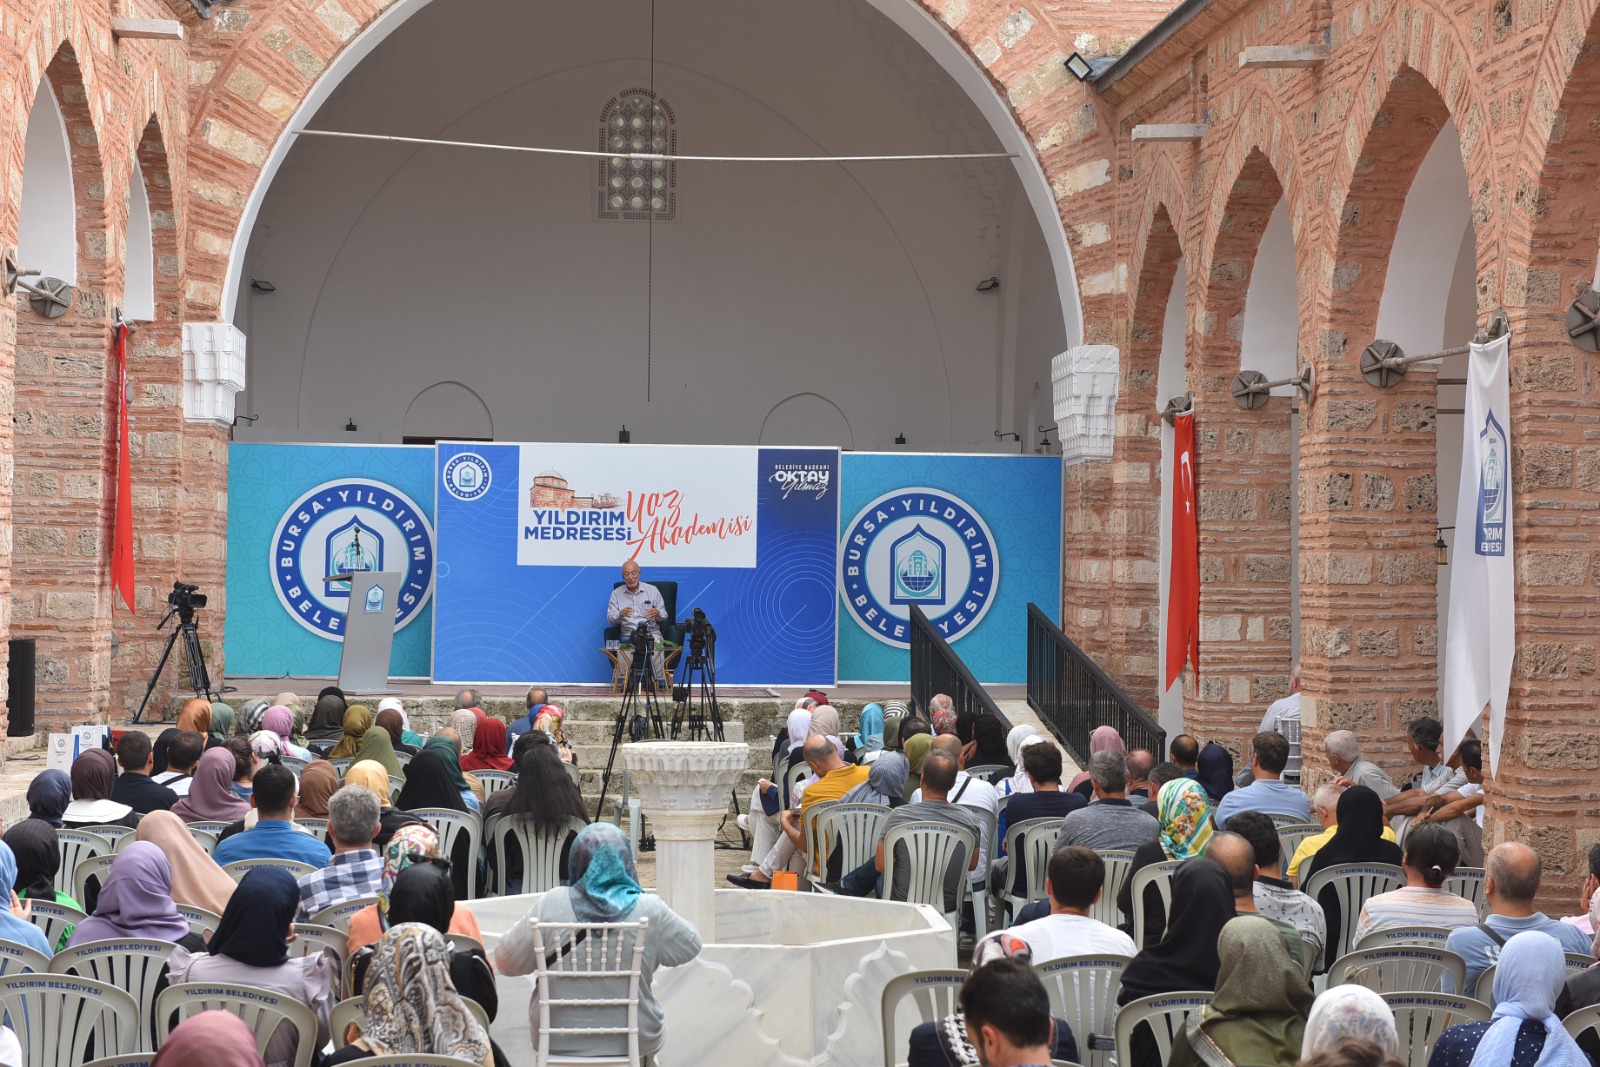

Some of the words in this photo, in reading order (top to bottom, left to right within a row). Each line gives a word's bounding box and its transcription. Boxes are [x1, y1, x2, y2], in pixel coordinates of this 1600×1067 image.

[775, 470, 830, 483] OKTAY
[532, 509, 625, 526] YILDIRIM
[281, 500, 325, 567] BURSA
[338, 490, 426, 562] YILDIRIM
[626, 512, 753, 562] Akademisi
[847, 510, 889, 576] BURSA
[901, 499, 987, 568] YILDIRIM
[854, 590, 984, 638] BELEYESİ
[75, 945, 112, 957] YILDIRIM
[1363, 951, 1399, 961] YILDIRIM
[1042, 961, 1077, 973] YILDIRIM
[5, 981, 46, 990] YILDIRIM
[914, 976, 953, 985] YILDIRIM
[184, 988, 224, 996] YILDIRIM
[1147, 998, 1187, 1008] YILDIRIM
[1388, 997, 1415, 1006] DIRIM
